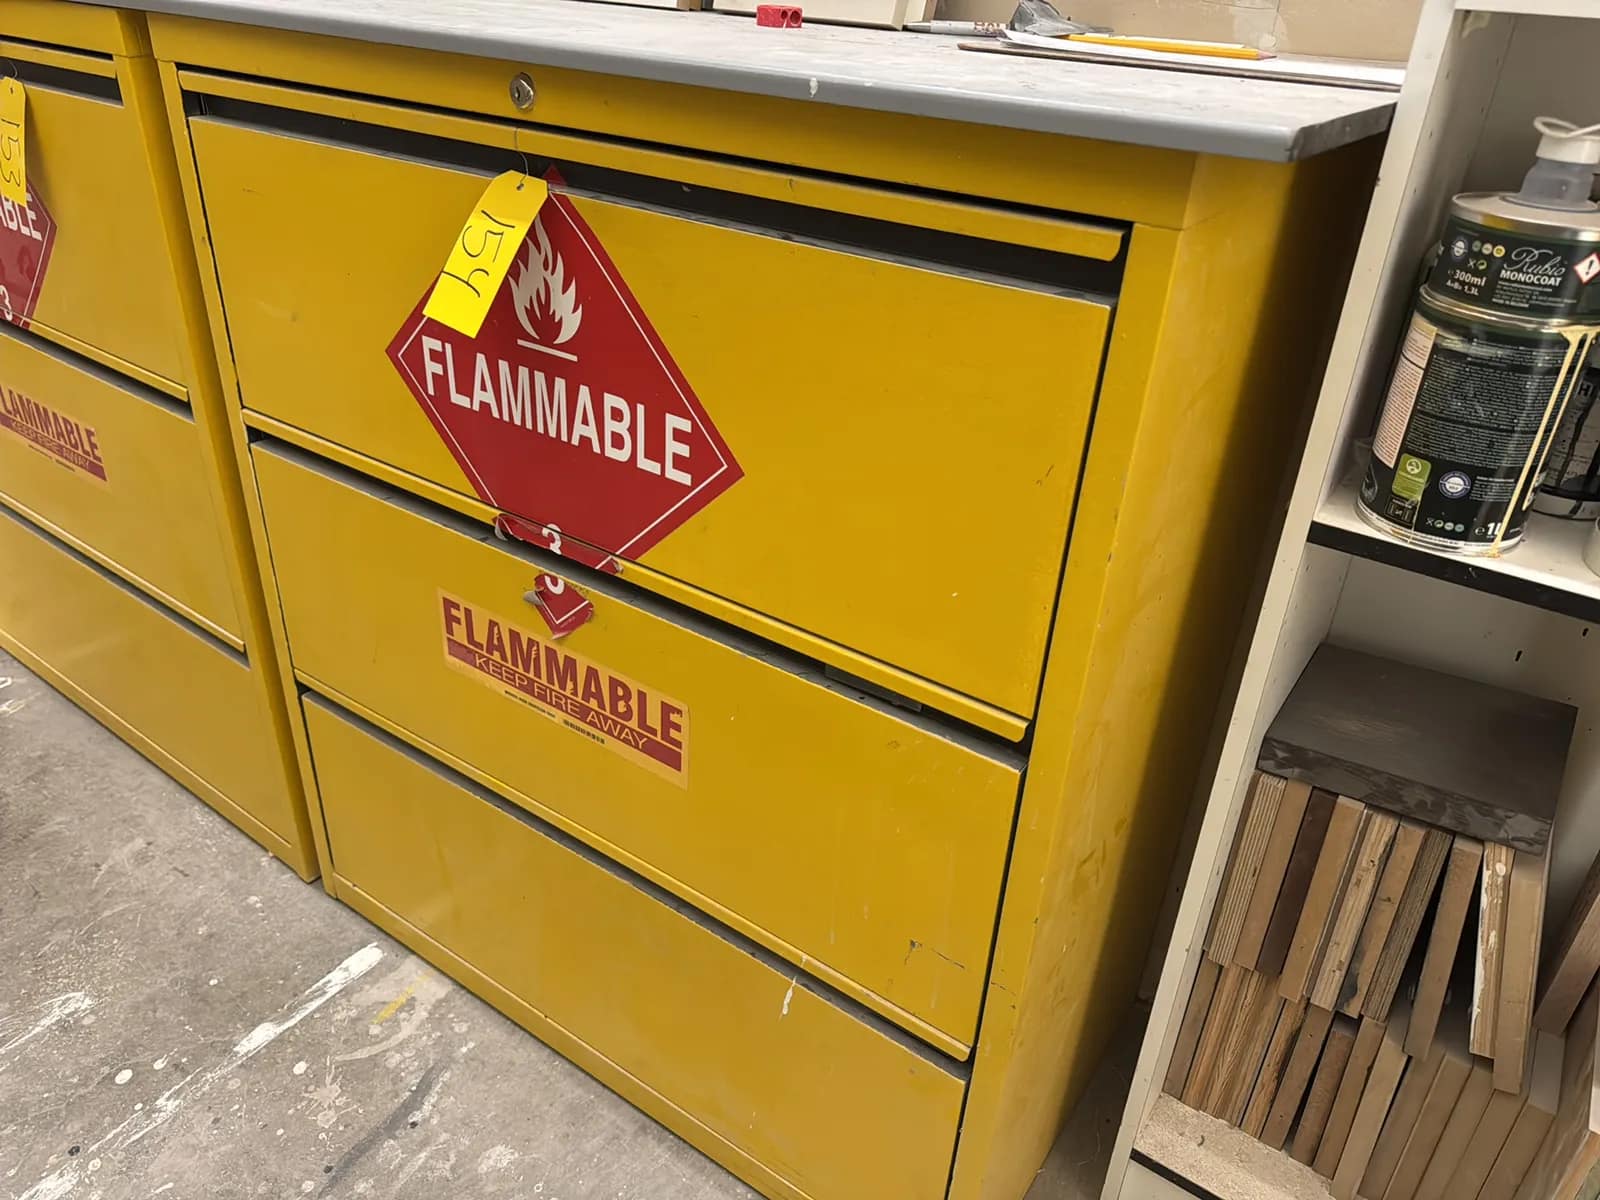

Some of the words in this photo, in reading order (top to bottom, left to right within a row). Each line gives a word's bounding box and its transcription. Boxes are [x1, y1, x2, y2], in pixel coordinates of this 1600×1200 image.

[441, 209, 516, 298] 154
[1453, 268, 1488, 288] 300ml
[1499, 269, 1562, 287] MONOCOAT
[1503, 246, 1566, 276] Rubio
[421, 335, 693, 487] FLAMMABLE
[442, 596, 683, 751] FLAMMABLE
[475, 655, 529, 688] KEEP
[534, 682, 581, 719] FIRE
[586, 711, 648, 751] AWAY
